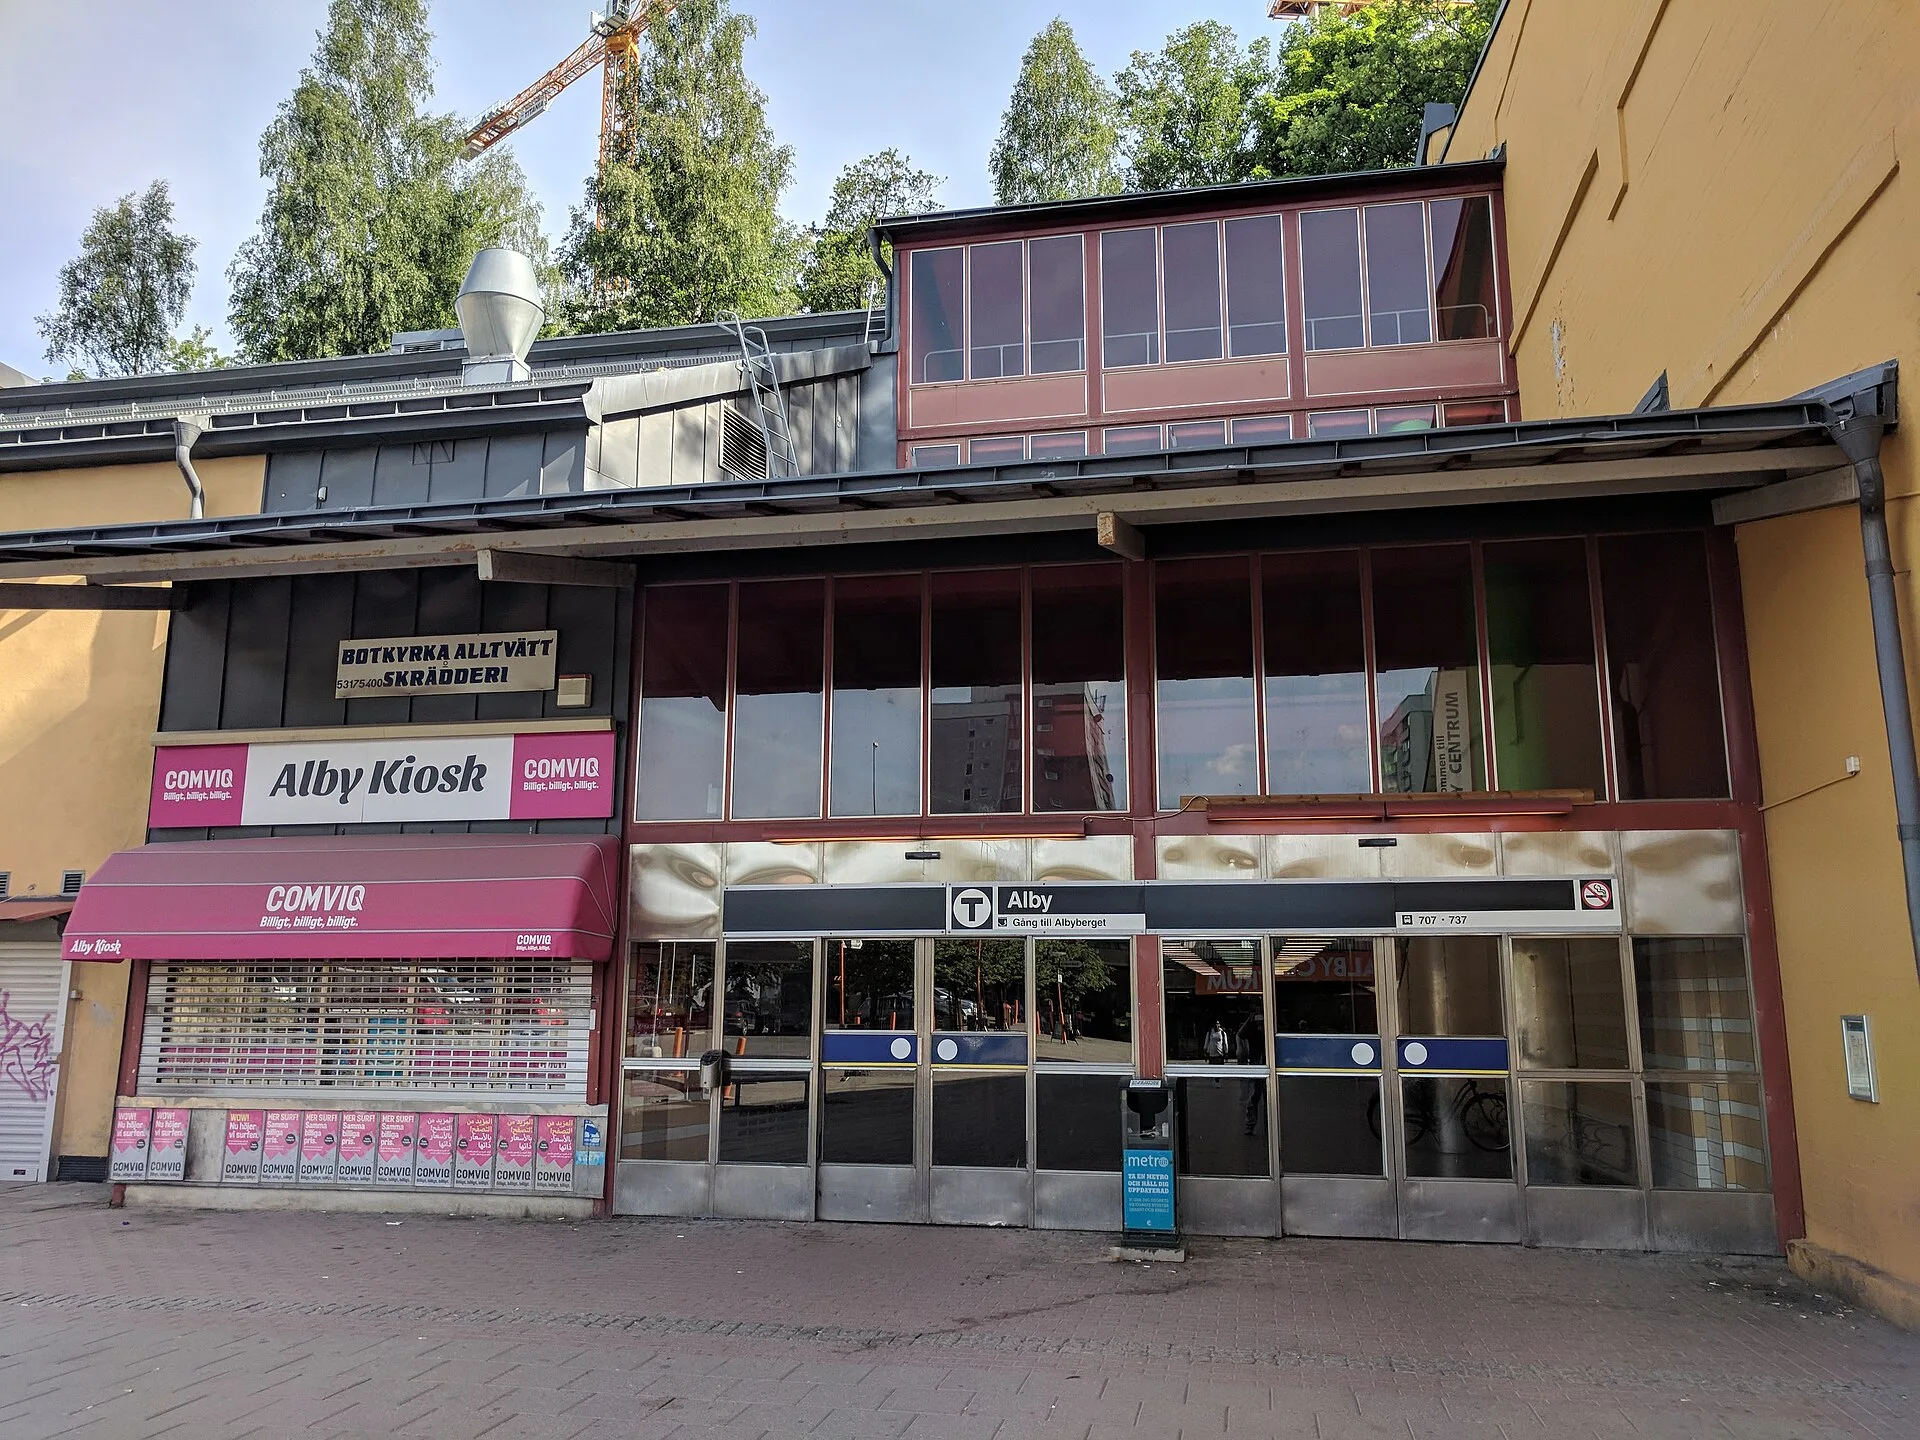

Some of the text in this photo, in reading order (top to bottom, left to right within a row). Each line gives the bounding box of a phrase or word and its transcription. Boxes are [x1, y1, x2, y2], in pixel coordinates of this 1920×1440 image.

[341, 638, 554, 665] BOTKYRKA ALLTVÄTT
[382, 666, 509, 687] SKRÄDDERI
[336, 678, 383, 690] 53175400
[1445, 692, 1463, 774] CENTRUM
[524, 757, 600, 779] COMVIQ
[1438, 753, 1447, 792] ommen
[165, 769, 233, 789] COMVIQ
[269, 755, 487, 804] Alby Kiosk
[523, 780, 599, 792] Billigt, billigt, billigt.
[163, 790, 232, 802] Billigt, billigt, billigt.
[266, 885, 366, 912] COMVIQ
[1007, 890, 1053, 912] Alby
[259, 915, 359, 929] Billigt, billigt, billigt.
[1012, 917, 1107, 928] Gång till Albyberget
[1418, 915, 1467, 925] 707 737
[516, 934, 552, 945] COMVIQ
[69, 939, 121, 956] Alby Kiosk
[230, 1122, 238, 1130] Nu
[343, 1122, 365, 1130] Samma
[381, 1123, 404, 1131] Samma
[113, 1162, 144, 1171] COMVIQ
[151, 1162, 181, 1171] COMVIQ
[1128, 1155, 1169, 1167] metro
[226, 1164, 257, 1173] COMVIQ
[263, 1164, 294, 1173] COMVIQ
[301, 1165, 333, 1174] COMVIQ
[339, 1166, 371, 1175] COMVIQ
[378, 1167, 411, 1176] COMVIQ
[417, 1168, 449, 1178] COMVIQ
[457, 1170, 489, 1179] COMVIQ
[497, 1171, 530, 1180] COMVIQ
[537, 1172, 570, 1181] COMVIQ
